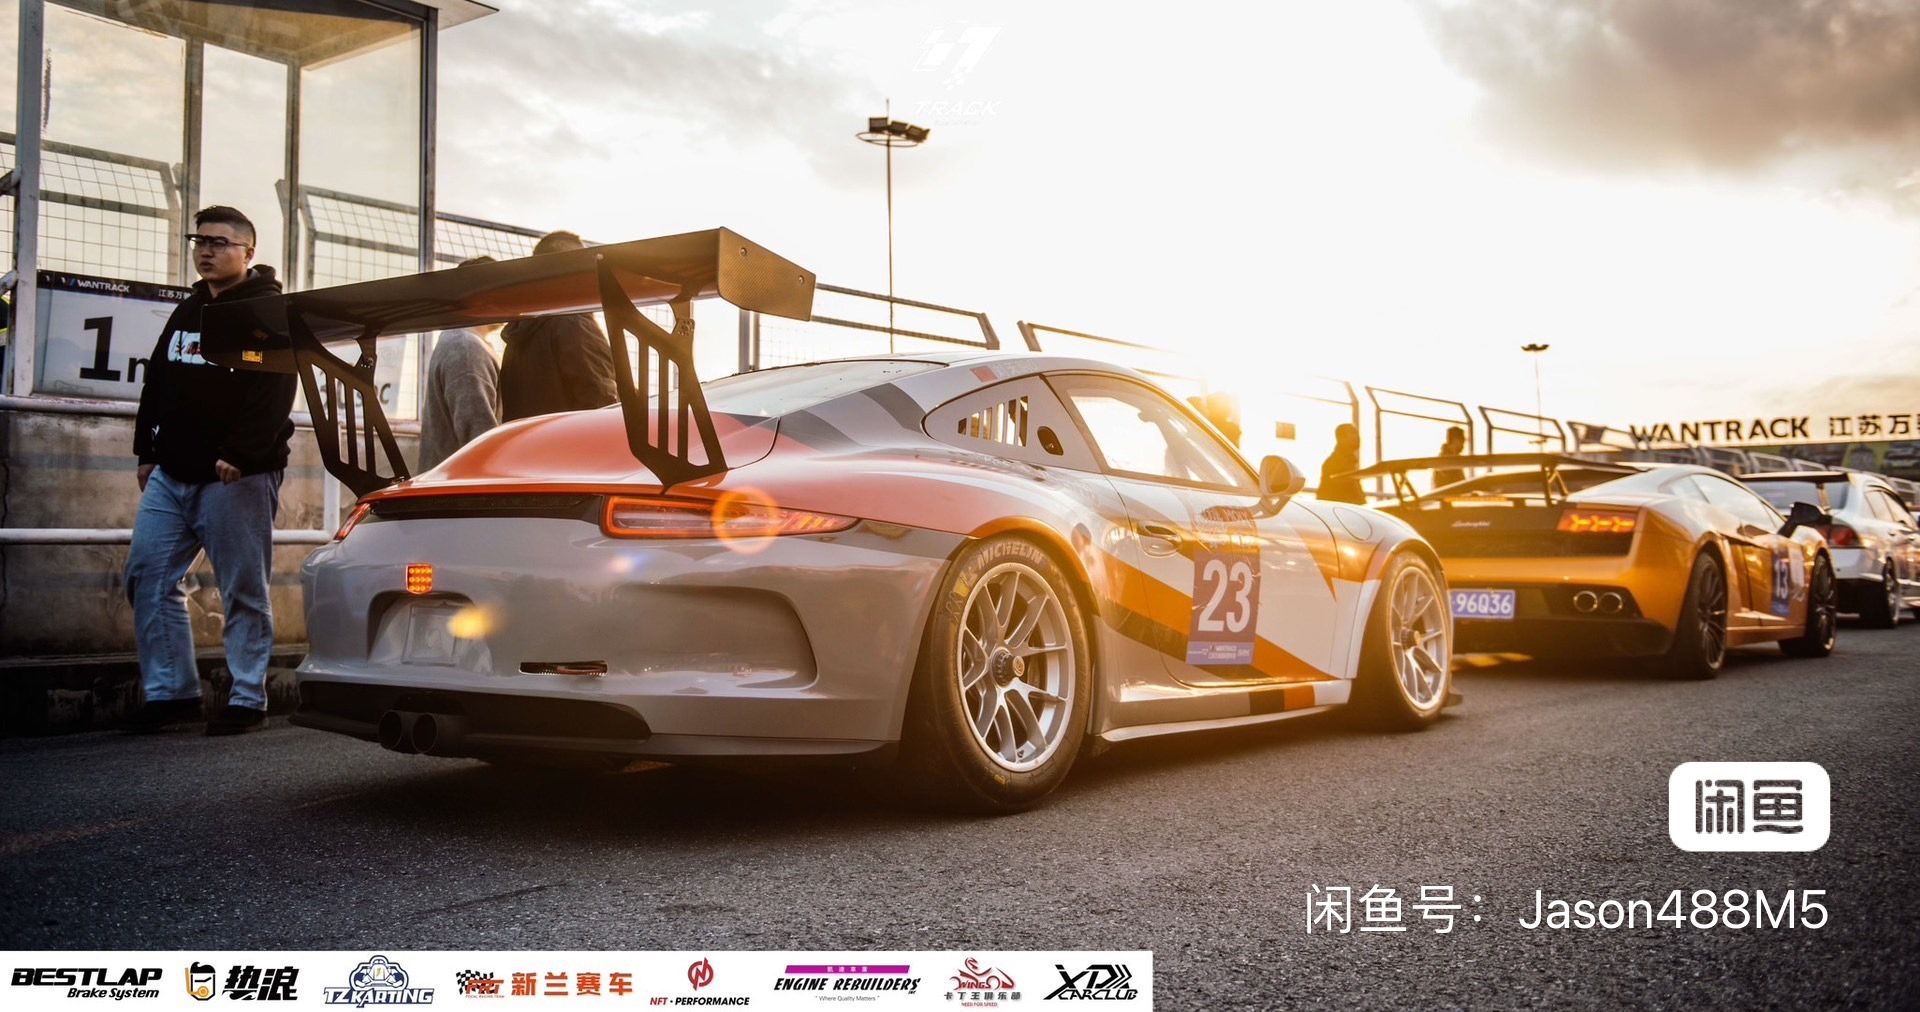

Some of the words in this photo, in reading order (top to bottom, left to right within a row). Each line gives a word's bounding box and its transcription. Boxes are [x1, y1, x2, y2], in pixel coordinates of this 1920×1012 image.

[77, 280, 130, 292] WANTRACK
[1630, 417, 1810, 443] WANTRACK
[1829, 412, 1920, 437] 江苏万
[977, 542, 1045, 569] MICHELIN
[1198, 559, 1251, 633] 23
